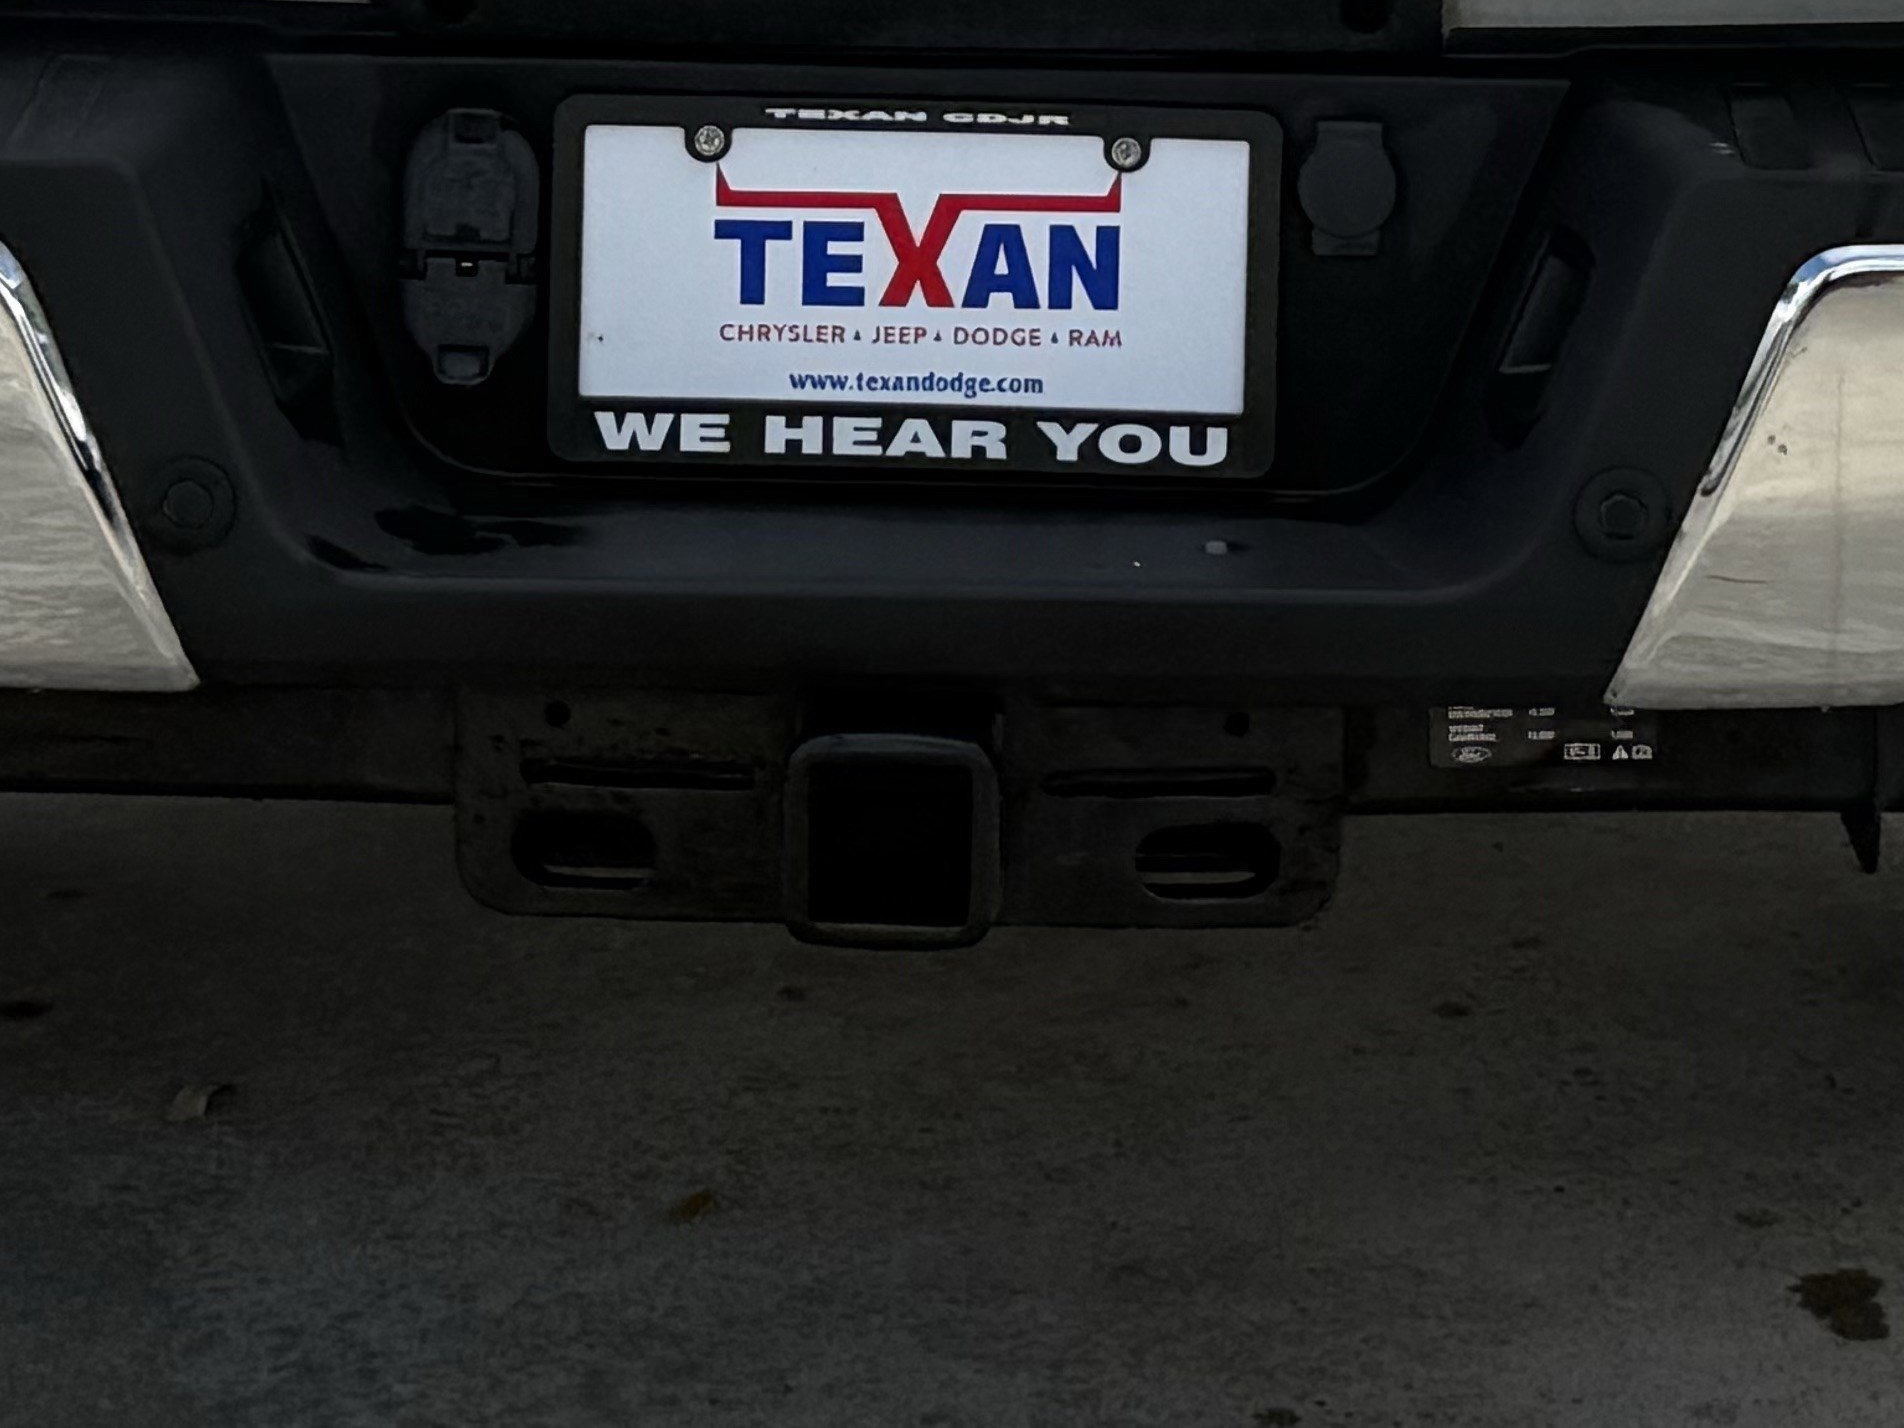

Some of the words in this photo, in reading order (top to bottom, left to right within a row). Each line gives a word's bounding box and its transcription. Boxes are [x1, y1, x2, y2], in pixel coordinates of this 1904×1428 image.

[765, 108, 927, 121] TEXAN
[714, 193, 1121, 311] TEXAN
[719, 323, 846, 345] CHRYSLER
[871, 326, 927, 345] JEEP
[953, 326, 1042, 347] DODGE
[1068, 329, 1123, 348] RAM
[789, 371, 1044, 398] www.texandodge.com
[595, 411, 731, 453] WE
[765, 415, 1007, 460] HEAR
[1037, 420, 1229, 467] YOU
